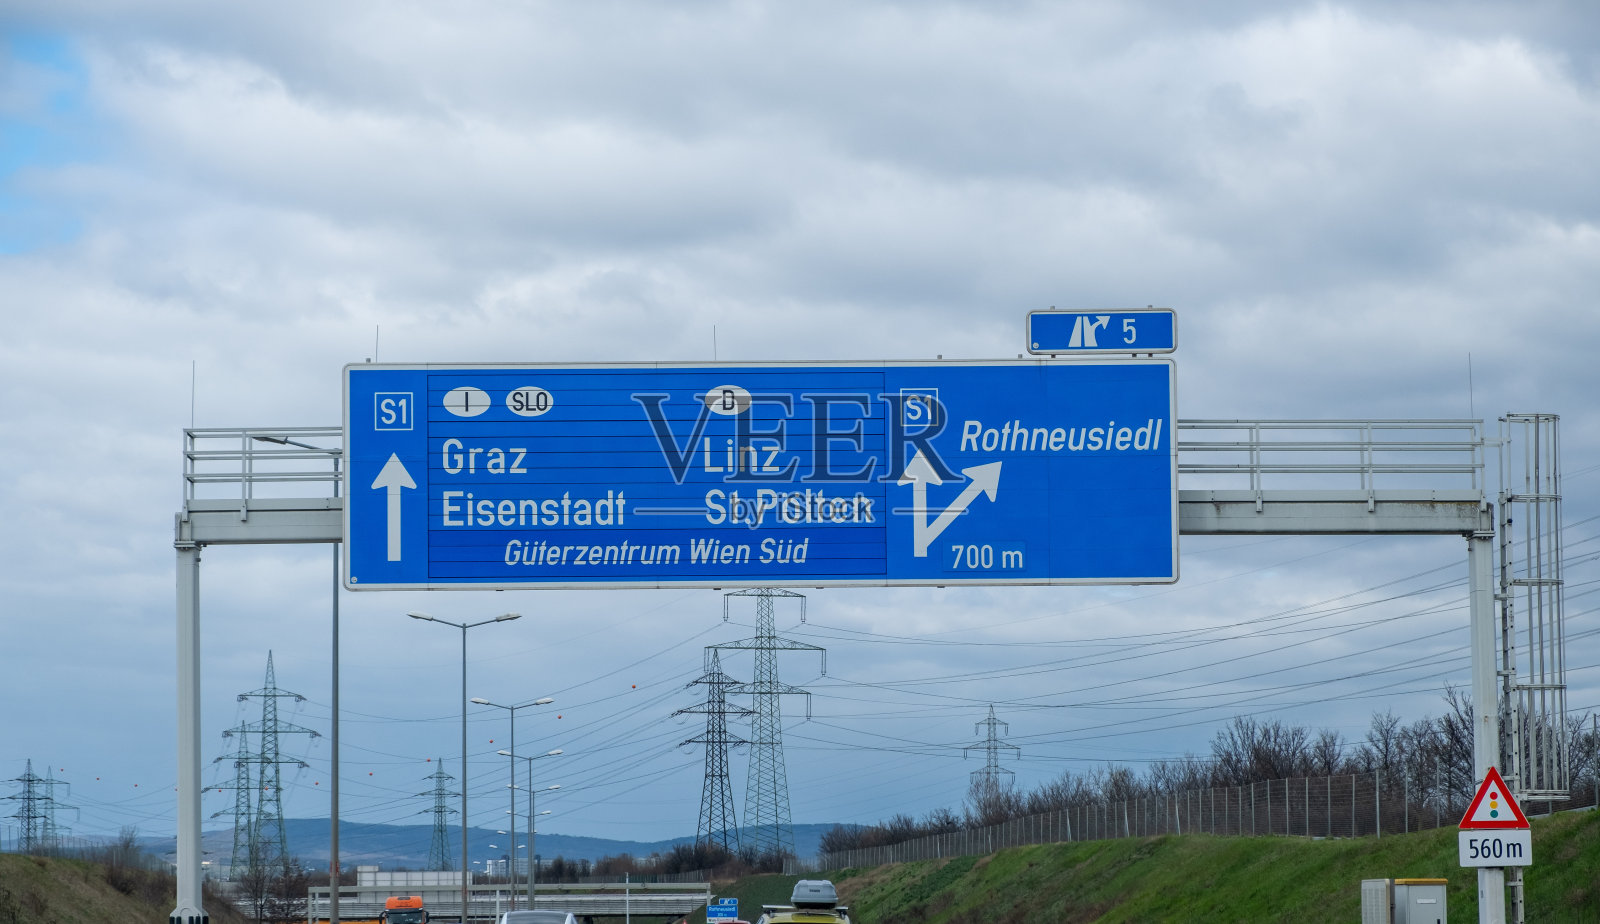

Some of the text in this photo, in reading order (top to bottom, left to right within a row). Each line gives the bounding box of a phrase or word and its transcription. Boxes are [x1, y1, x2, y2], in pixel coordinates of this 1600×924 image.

[1122, 318, 1137, 344] 5
[380, 398, 407, 424] S1
[512, 391, 548, 412] SLO
[722, 389, 735, 411] D
[906, 394, 933, 420] S1
[960, 418, 1163, 452] Rothneusiedl
[442, 438, 528, 475] Graz
[704, 437, 780, 473] Linz
[442, 490, 626, 527] Eisenstadt
[504, 537, 809, 566] Güterzentrum Wien Süd
[951, 544, 1024, 569] 700 m
[1469, 838, 1503, 859] 560
